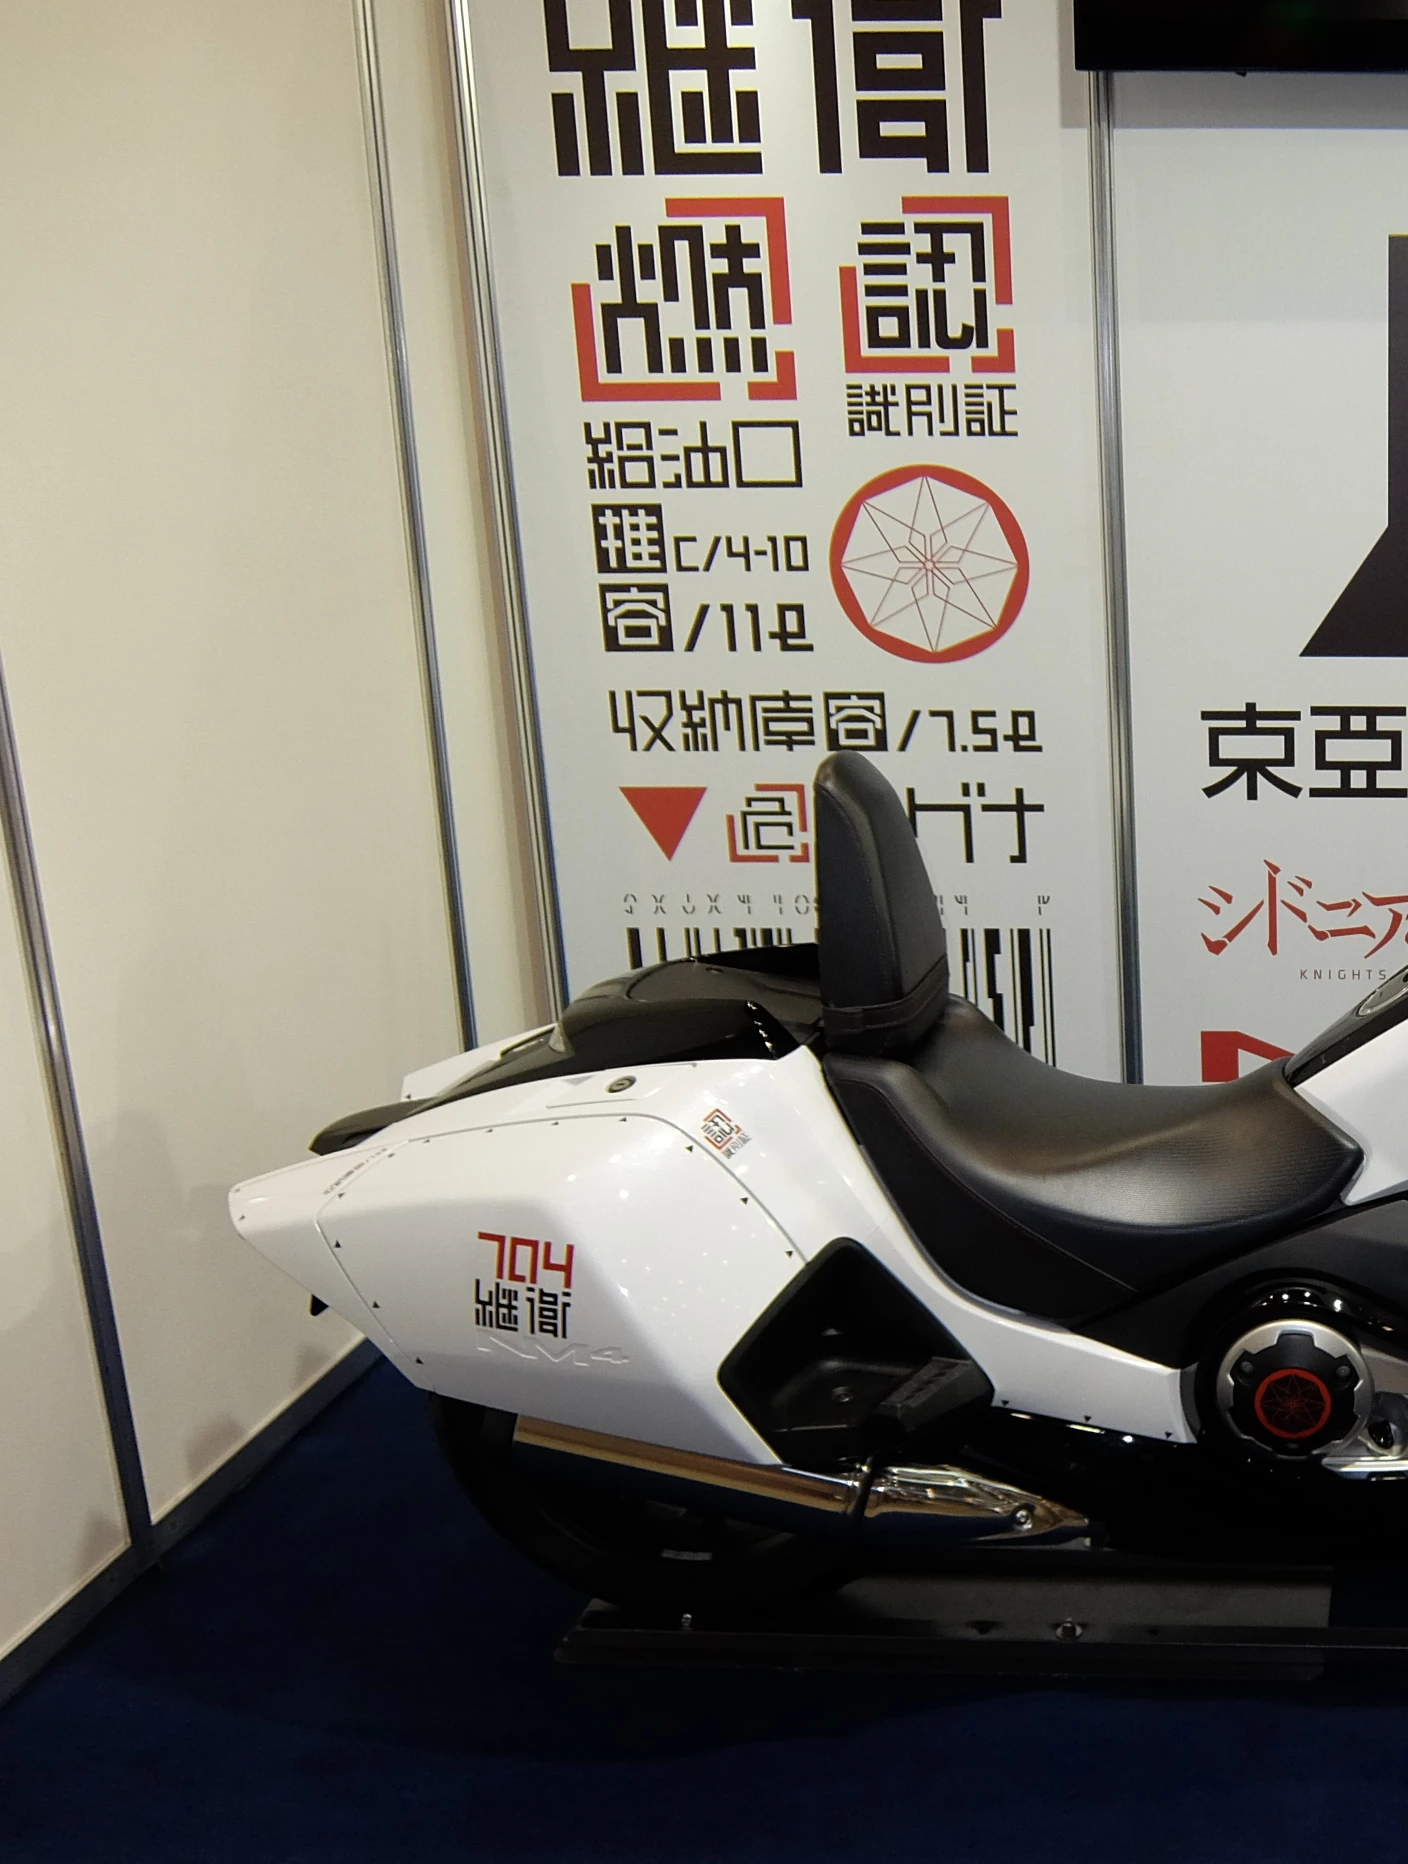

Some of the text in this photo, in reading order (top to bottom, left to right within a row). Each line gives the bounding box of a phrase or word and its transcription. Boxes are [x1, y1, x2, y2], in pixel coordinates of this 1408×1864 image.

[845, 383, 1019, 437] 識別証
[583, 420, 803, 489] 給油口
[1300, 968, 1388, 981] KNIGHTS
[477, 1231, 575, 1290] 704
